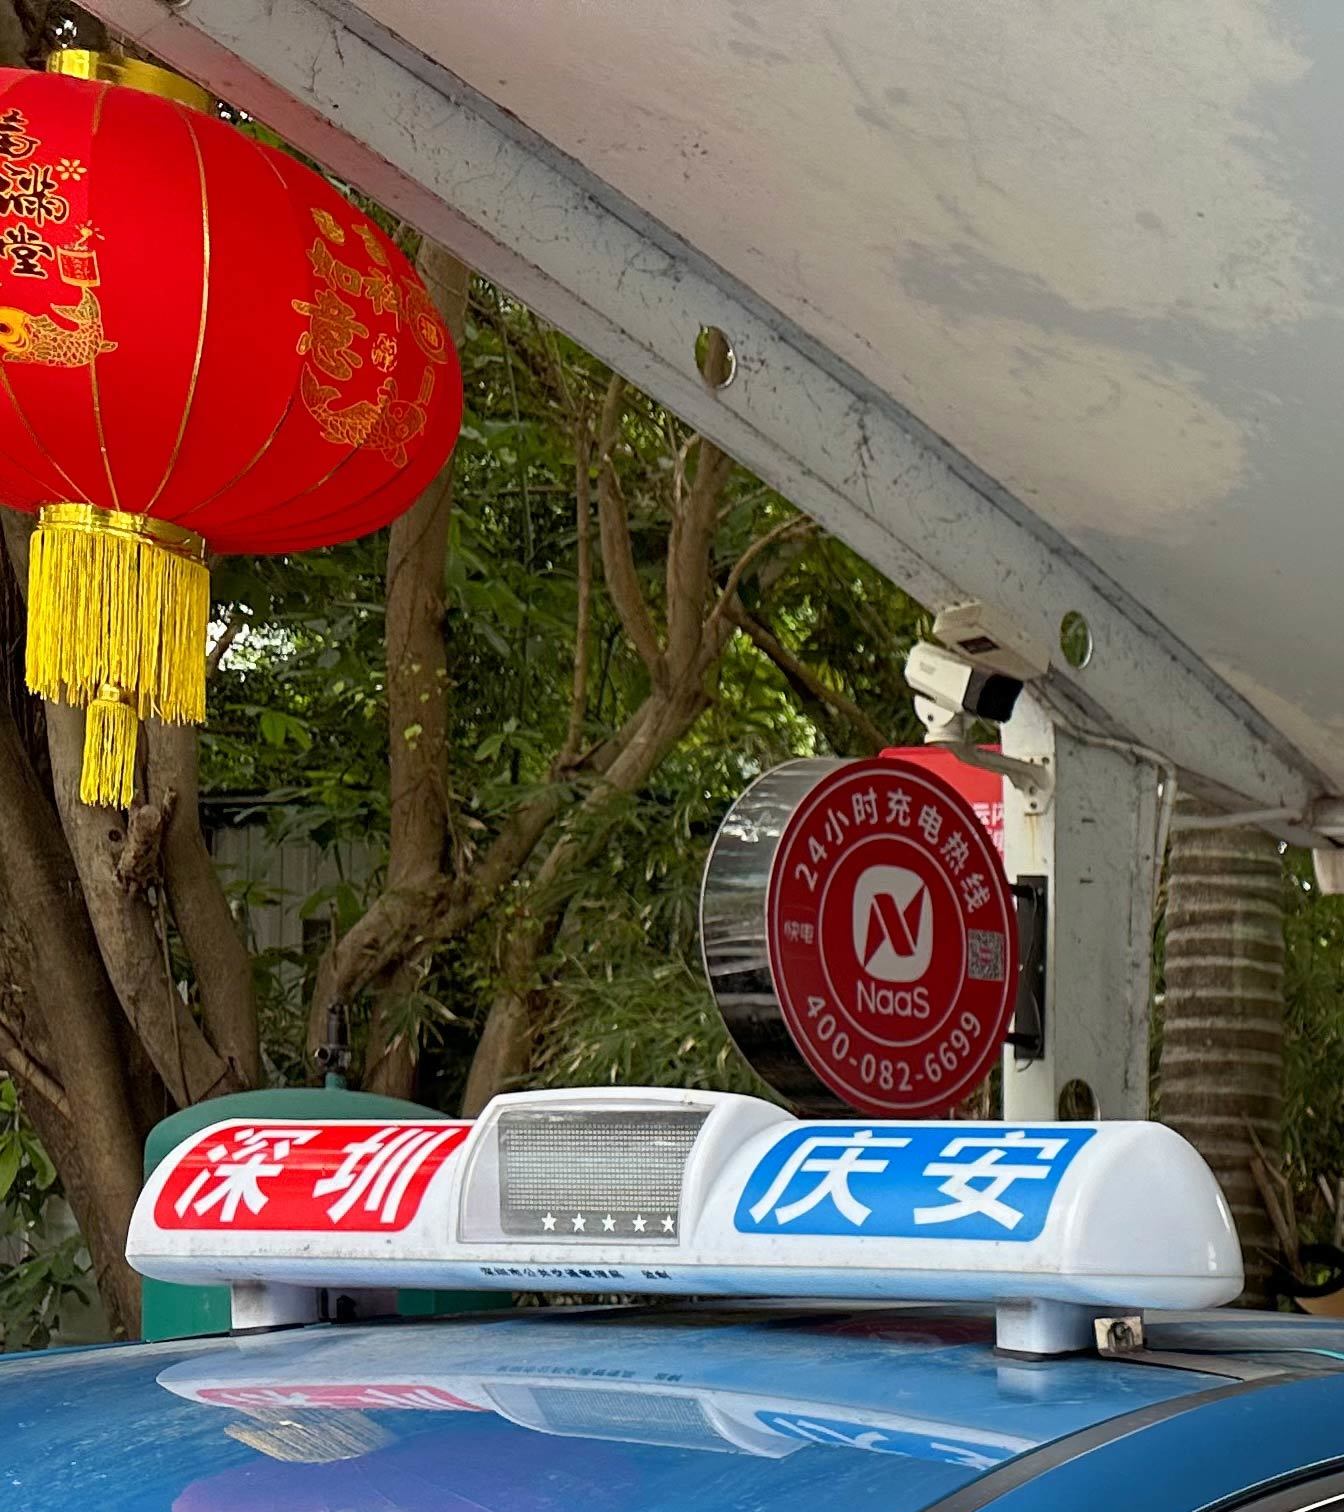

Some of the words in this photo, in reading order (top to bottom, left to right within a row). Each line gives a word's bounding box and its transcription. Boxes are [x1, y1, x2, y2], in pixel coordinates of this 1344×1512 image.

[796, 786, 991, 913] 24小时充电热线
[806, 994, 981, 1093] 400-082-6699
[856, 980, 931, 1019] NaaS
[173, 1125, 463, 1225] 深圳
[748, 1130, 1070, 1231] 庆安
